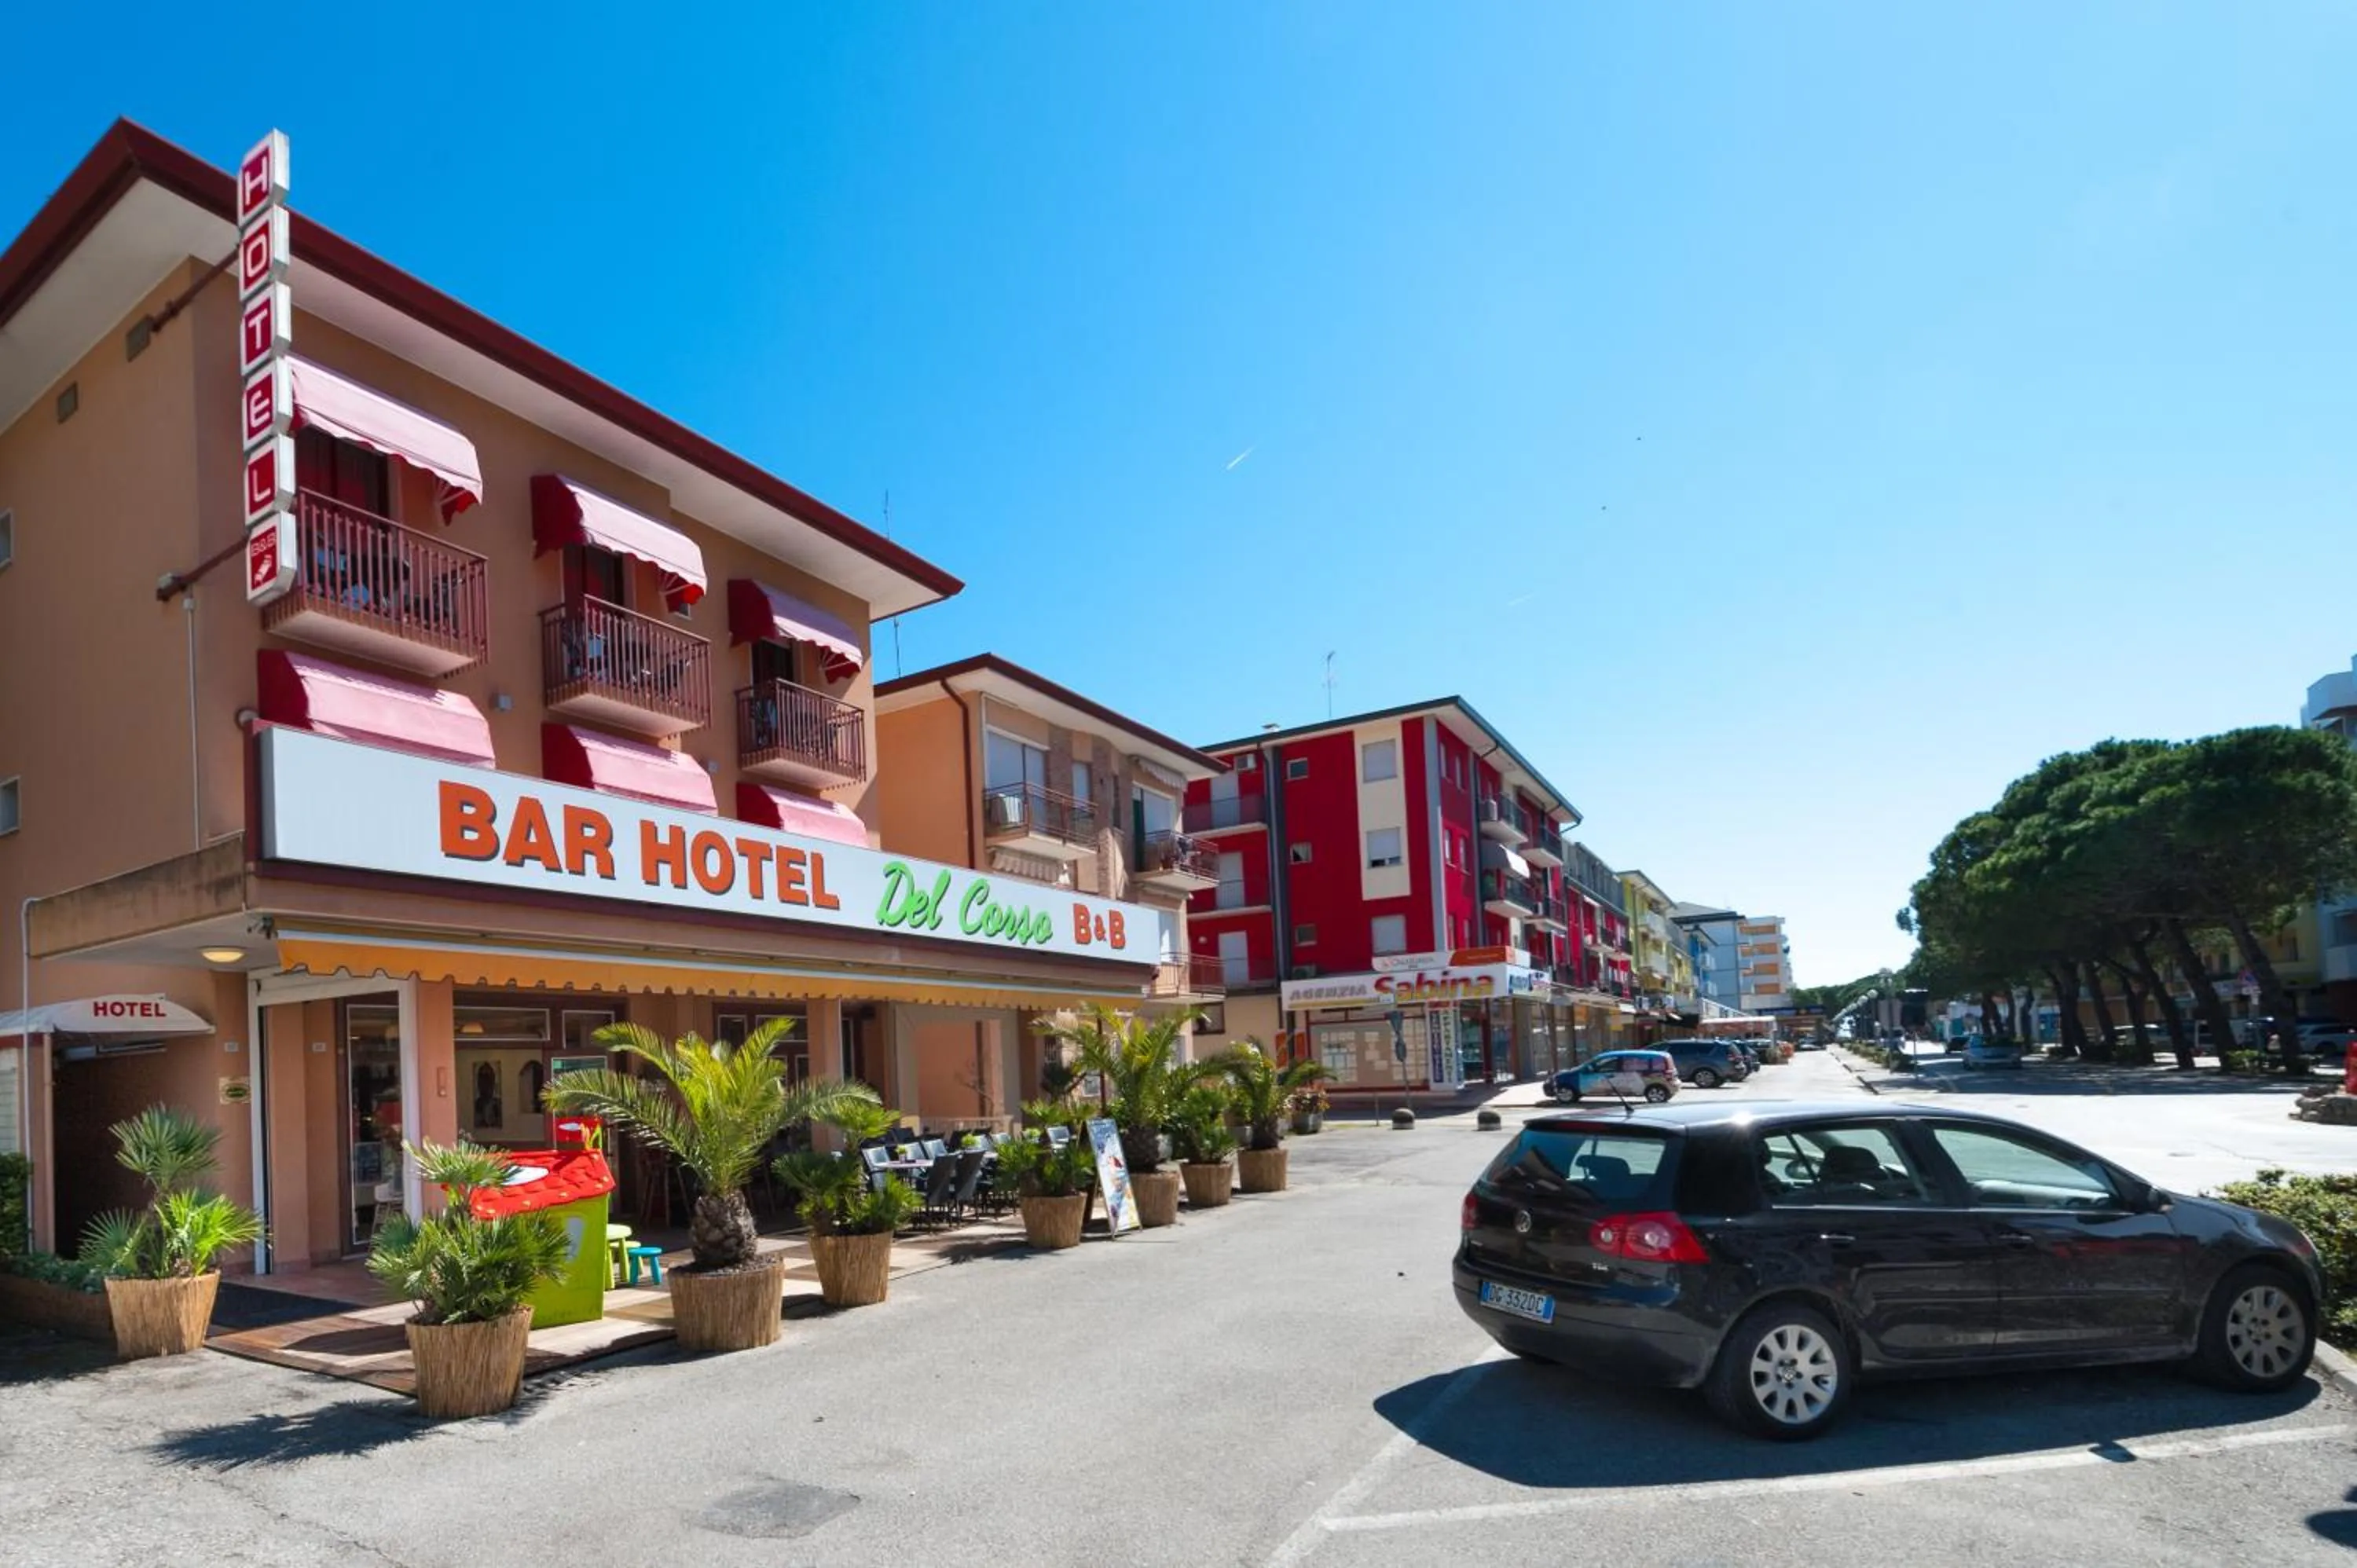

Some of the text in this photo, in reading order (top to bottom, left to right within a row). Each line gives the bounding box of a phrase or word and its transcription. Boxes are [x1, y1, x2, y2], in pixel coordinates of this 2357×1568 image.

[244, 156, 272, 503] HOTEL
[251, 532, 276, 557] B&B
[439, 780, 616, 880] BAR
[639, 819, 840, 910] HOTEL
[875, 861, 951, 930] Del
[958, 877, 1053, 944] Corso
[1373, 969, 1495, 1003] Sabina
[93, 1001, 167, 1017] HOTEL
